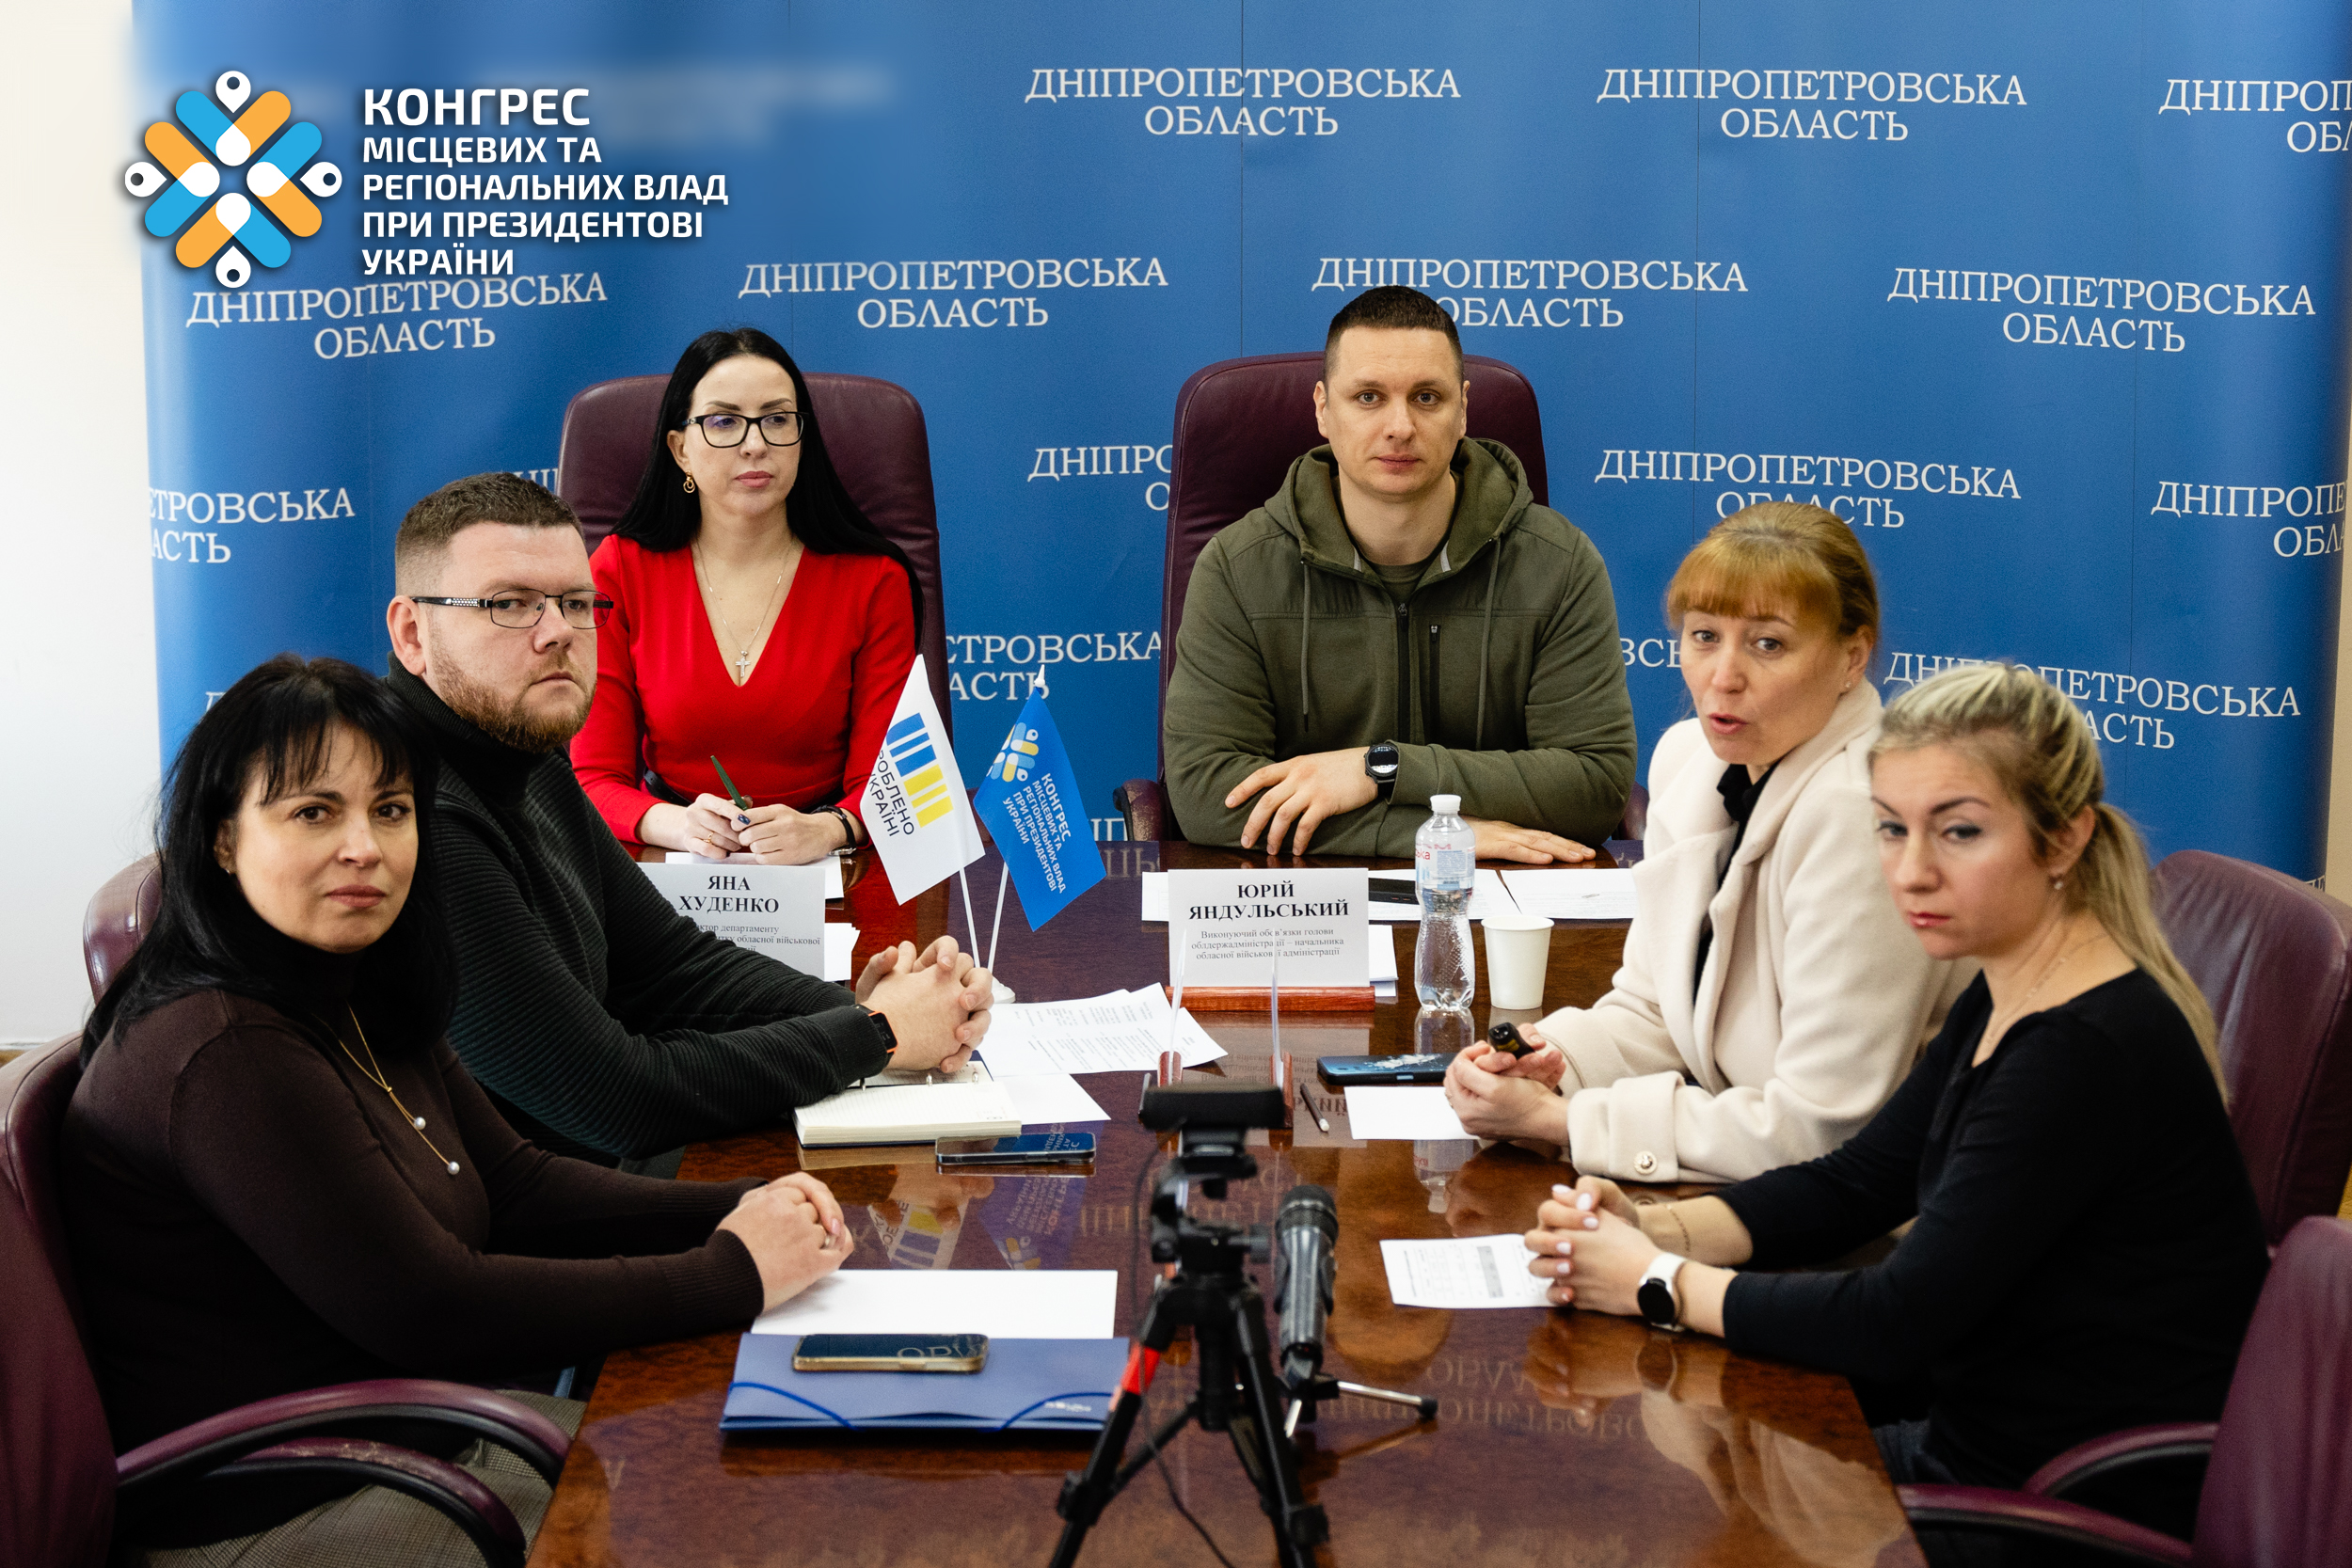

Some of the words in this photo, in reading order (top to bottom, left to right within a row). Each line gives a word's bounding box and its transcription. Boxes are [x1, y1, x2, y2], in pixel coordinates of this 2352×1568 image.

[1025, 69, 1461, 103] ДНІПРОПЕТРОВСЬКА
[1597, 69, 2026, 105] ДНІПРОПЕТРОВСЬКА
[1144, 105, 1339, 135] ОБЛАСТЬ
[1721, 108, 1908, 141] ОБЛАСТЬ
[739, 257, 1168, 299] ДНІПРОПЕТРОВСЬКА
[1311, 258, 1748, 292] ДНІПРОПЕТРОВСЬКА
[1887, 268, 2315, 316] ДНІПРОПЕТРОВСЬКА
[186, 273, 608, 328] ДНІПРОПЕТРОВСЬКА
[857, 296, 1048, 328] ОБЛАСТЬ
[314, 318, 496, 359] ОБЛАСТЬ
[2002, 312, 2185, 353] ОБЛАСТЬ
[1595, 450, 2021, 499] ДНІПРОПЕТРОВСЬКА
[869, 774, 899, 836] КРАЇНІ
[1002, 797, 1030, 845] УКРАЇНИ
[1032, 780, 1057, 836] МІСЦЕВИХ
[1053, 836, 1062, 851] ТА
[1041, 772, 1071, 842] КОНГРЕС
[1012, 791, 1029, 816] ПРИ
[1024, 815, 1057, 892] ПРЕЗИДЕНТОВІ
[1023, 785, 1057, 863] РЕГІОНАЛЬНИХ
[1052, 863, 1067, 894] ВЛАД
[707, 876, 751, 891] ЯНА
[1237, 880, 1295, 898] ЮРІЙ
[678, 895, 780, 914] ХУДЕНКО
[1189, 899, 1349, 922] ЯНДУЛЬСЬКИЙ
[721, 925, 780, 935] департаменту
[1295, 938, 1344, 947] начальника
[1304, 928, 1334, 937] голови
[1196, 951, 1234, 960] обласної
[1236, 949, 1281, 959] військовї
